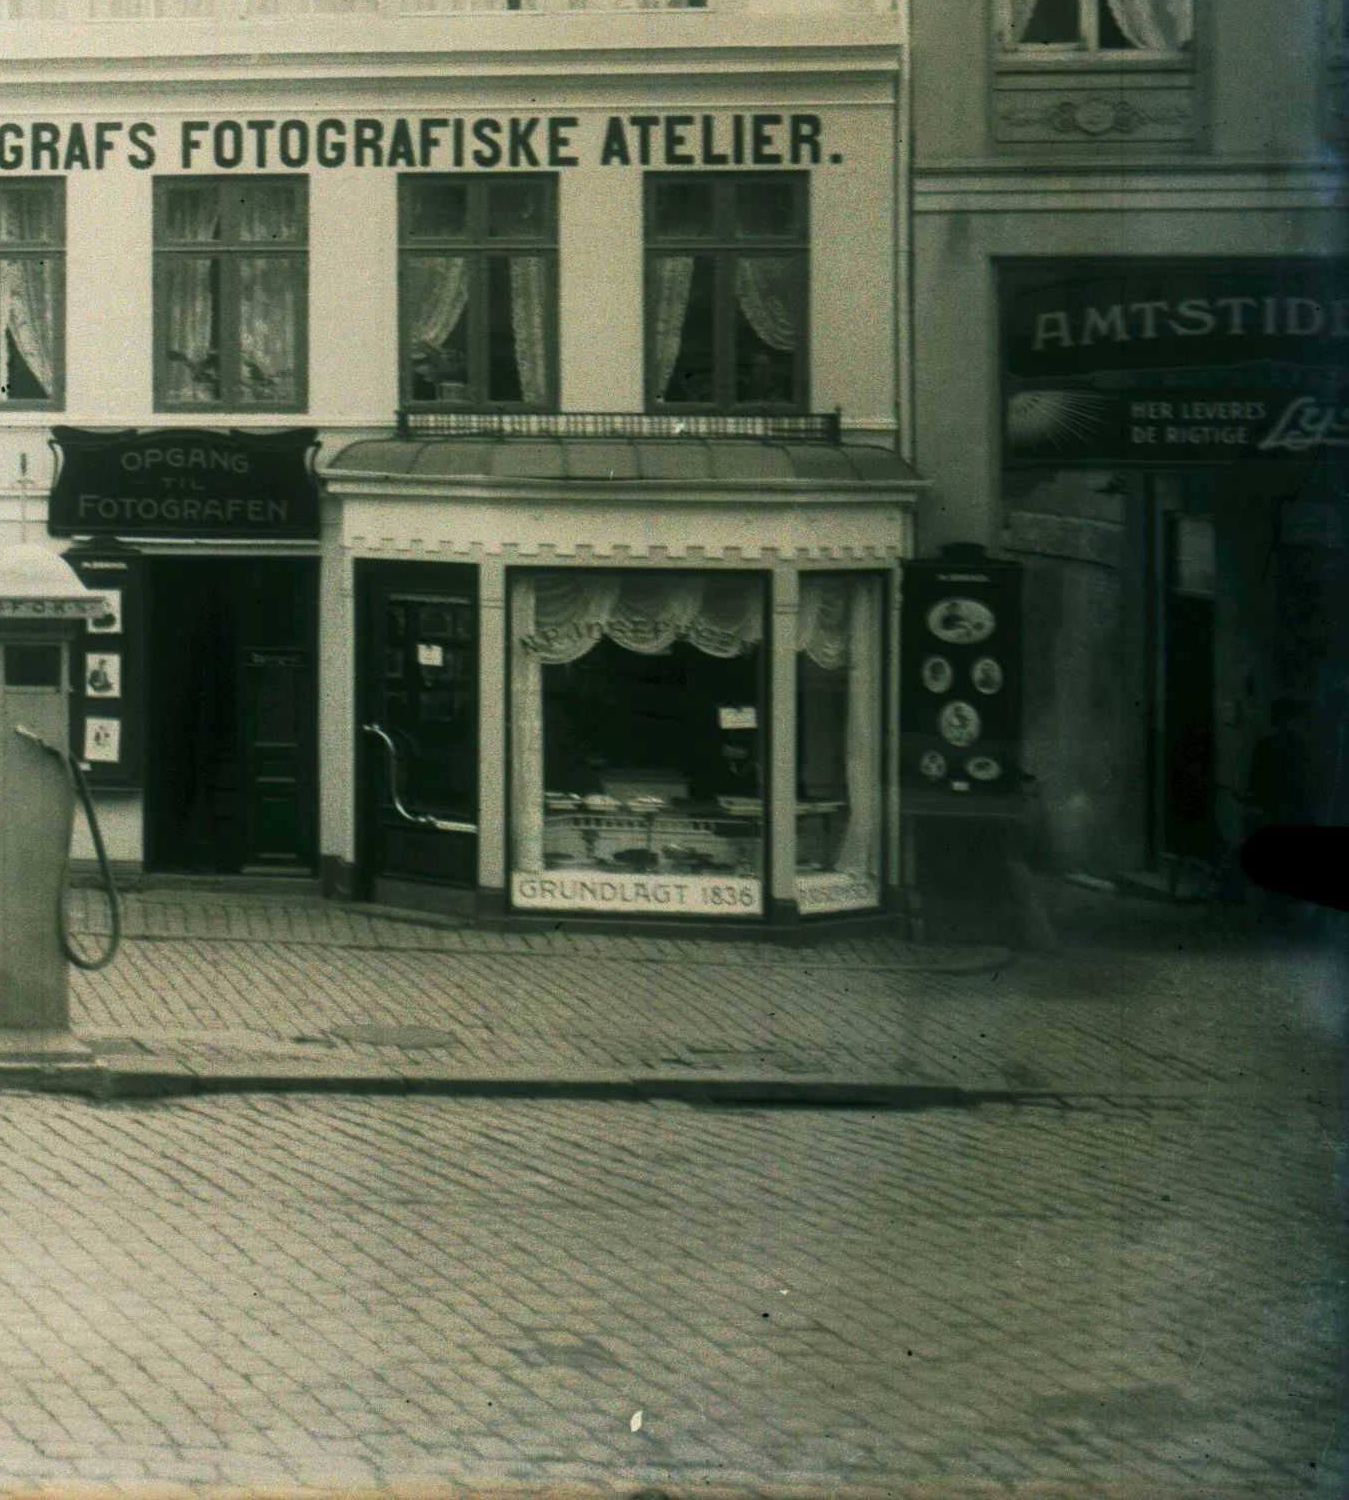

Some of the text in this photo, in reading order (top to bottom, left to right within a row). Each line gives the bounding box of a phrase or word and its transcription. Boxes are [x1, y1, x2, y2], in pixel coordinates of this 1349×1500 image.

[181, 116, 579, 170] FOTOGRAFISKE
[600, 113, 844, 167] ATELIER.
[1131, 402, 1174, 421] HER
[1131, 425, 1157, 445] DE
[120, 448, 250, 474] OPGANG
[161, 476, 205, 492] TIL
[78, 494, 289, 523] FOTOGRAFEN
[518, 880, 754, 908] GRUNDLAGT 1836
